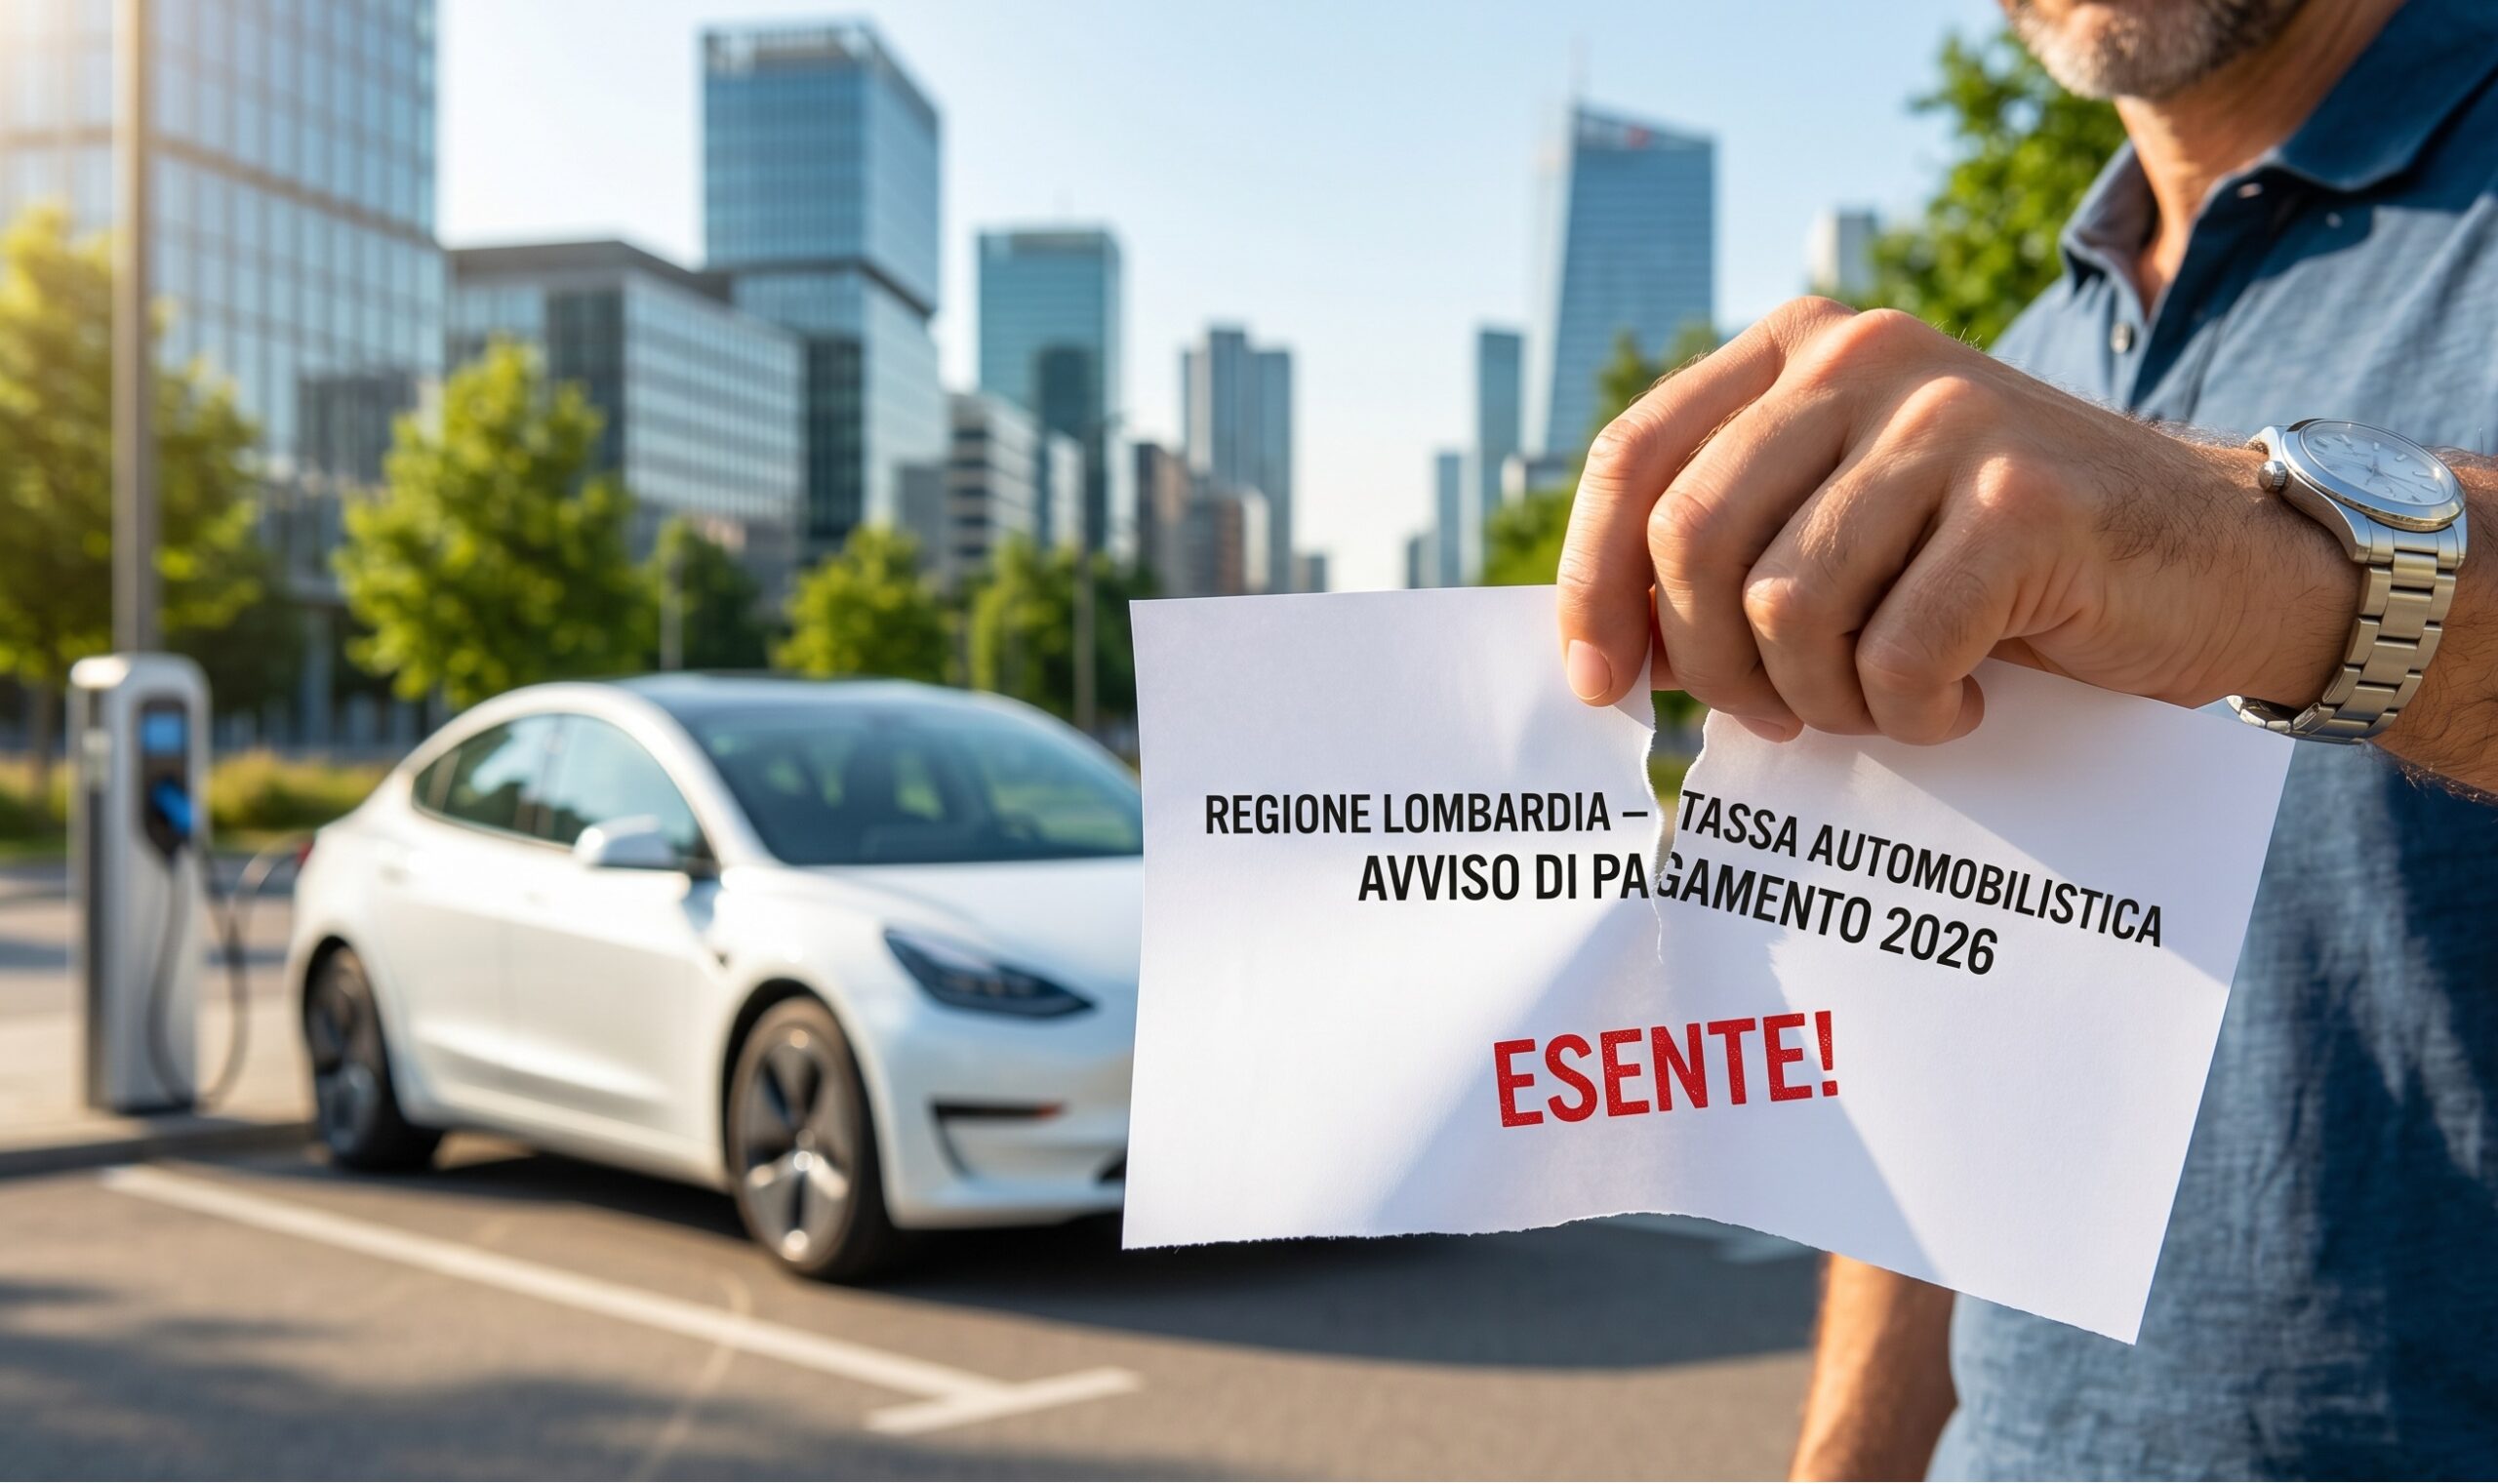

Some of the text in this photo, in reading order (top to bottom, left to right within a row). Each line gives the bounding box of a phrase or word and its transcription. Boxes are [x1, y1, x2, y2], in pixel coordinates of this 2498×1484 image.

[1206, 793, 1372, 834] REGIONE
[1384, 791, 1611, 833] LOMBARDIA
[1680, 789, 1797, 858] TASSA
[1806, 823, 2162, 948] AUTOMOBILISTICA
[1358, 851, 1998, 976] AVVISO DI PAGAMENTO 2026
[1493, 1009, 1839, 1129] ESENTE!
